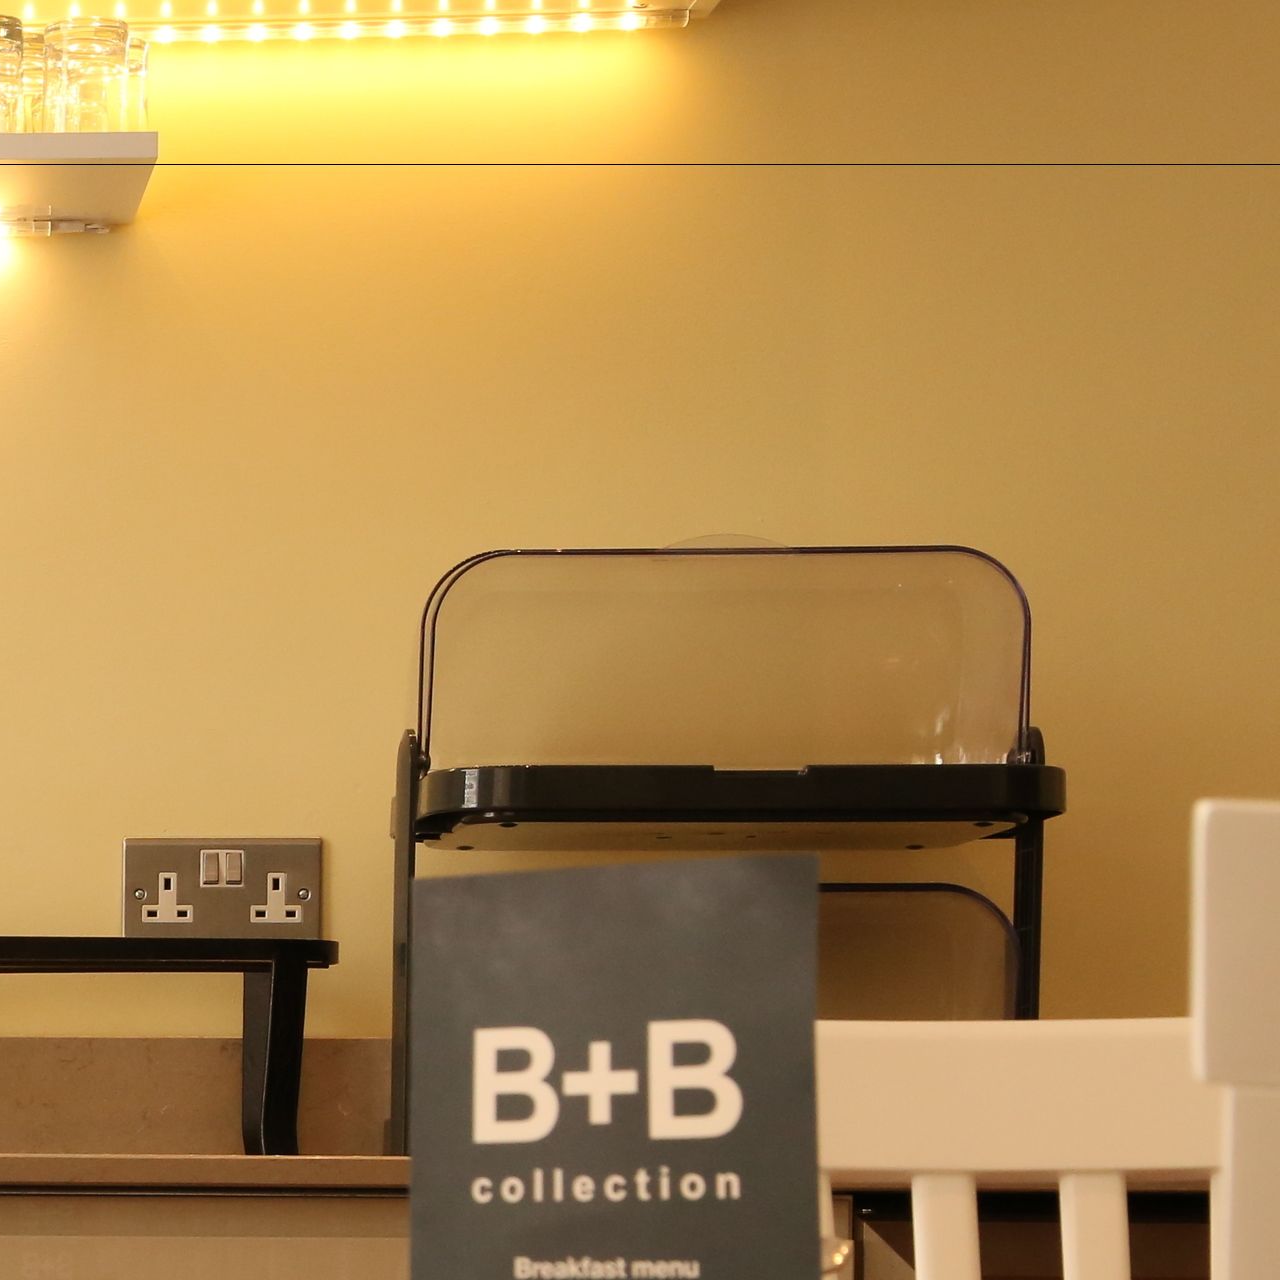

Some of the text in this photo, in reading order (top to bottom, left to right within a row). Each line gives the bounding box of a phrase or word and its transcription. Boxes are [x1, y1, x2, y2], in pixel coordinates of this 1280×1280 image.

[471, 1018, 743, 1145] B+B
[471, 1165, 742, 1204] collection
[513, 1255, 701, 1280] Breakfast menu
